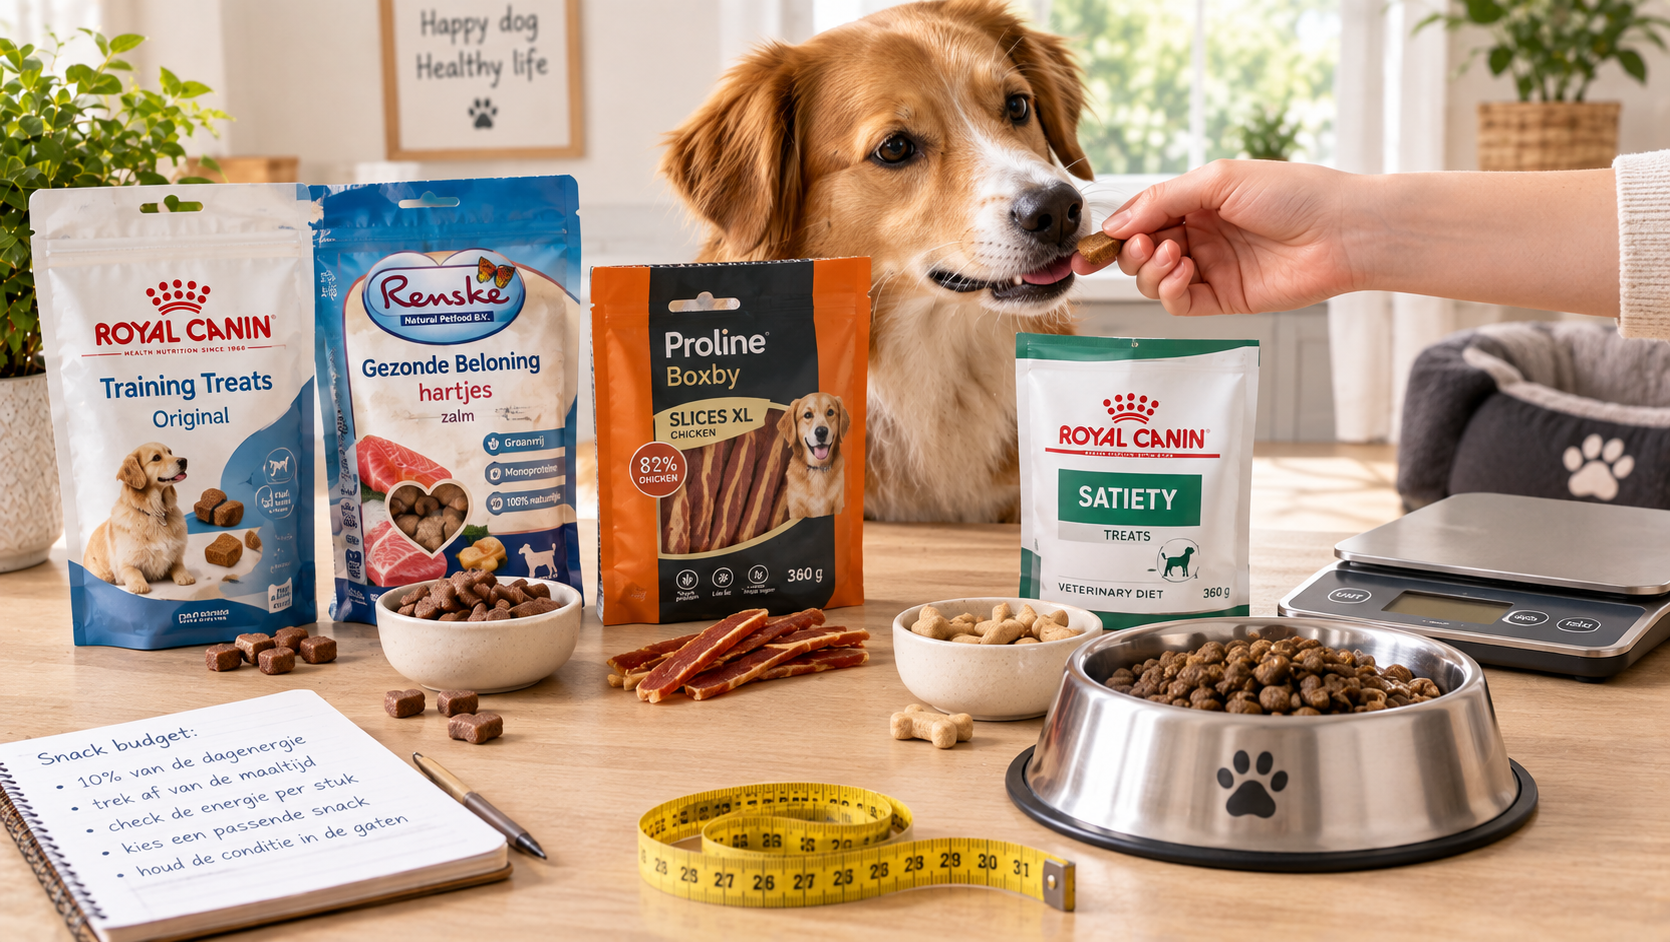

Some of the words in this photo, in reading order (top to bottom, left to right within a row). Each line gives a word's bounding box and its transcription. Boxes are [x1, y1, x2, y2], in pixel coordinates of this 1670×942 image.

[420, 8, 489, 45] Happy
[498, 4, 538, 43] dog
[416, 50, 503, 89] Healthy
[513, 47, 549, 82] life
[380, 275, 510, 309] Renske
[95, 320, 181, 346] ROYAL
[405, 315, 437, 325] Natural
[156, 347, 198, 355] NUTRITION
[665, 328, 767, 359] Proline
[362, 355, 449, 378] Gezonde
[455, 351, 541, 374] Beloning
[666, 363, 741, 390] Boxby
[99, 374, 196, 400] Training
[200, 371, 273, 394] Treats
[419, 381, 493, 405] hartjes
[153, 406, 230, 431] Original
[441, 409, 475, 423] zalm
[669, 408, 728, 428] SLICES
[732, 407, 754, 424] XL
[670, 428, 716, 441] CHICKEN
[1059, 424, 1127, 448] ROYAL
[640, 455, 678, 474] 82%
[1078, 485, 1178, 511] SATIETY
[1103, 529, 1151, 542] TREATS
[815, 568, 823, 584] g
[1058, 582, 1132, 599] VETERINARY
[1136, 589, 1164, 599] DIET
[1203, 586, 1222, 599] 360
[1224, 587, 1230, 599] g
[37, 743, 108, 766] Snack
[112, 727, 198, 752] budget:
[77, 770, 122, 789] 10%
[129, 764, 165, 778] van
[172, 757, 195, 770] de
[202, 735, 307, 764] dagenergie
[92, 793, 136, 810] trek
[141, 786, 161, 800] af
[168, 781, 203, 795] van
[209, 774, 233, 788] de
[238, 755, 317, 781] maaltijd
[109, 812, 165, 832] check
[171, 807, 194, 820] de
[201, 792, 270, 810] energie
[275, 784, 306, 802] per
[314, 773, 359, 791] stuk
[121, 840, 164, 855] kies
[171, 831, 207, 845] een
[213, 810, 305, 841] passende
[312, 795, 371, 817] snack
[136, 857, 185, 877] houd
[192, 853, 215, 867] de
[222, 838, 294, 861] conditie
[298, 833, 319, 845] in
[324, 825, 348, 840] de
[354, 815, 409, 838] gaten
[714, 872, 735, 889] 27
[753, 875, 775, 891] 26
[793, 874, 815, 890] 27
[978, 853, 998, 871] 30
[1013, 859, 1030, 878] 31
